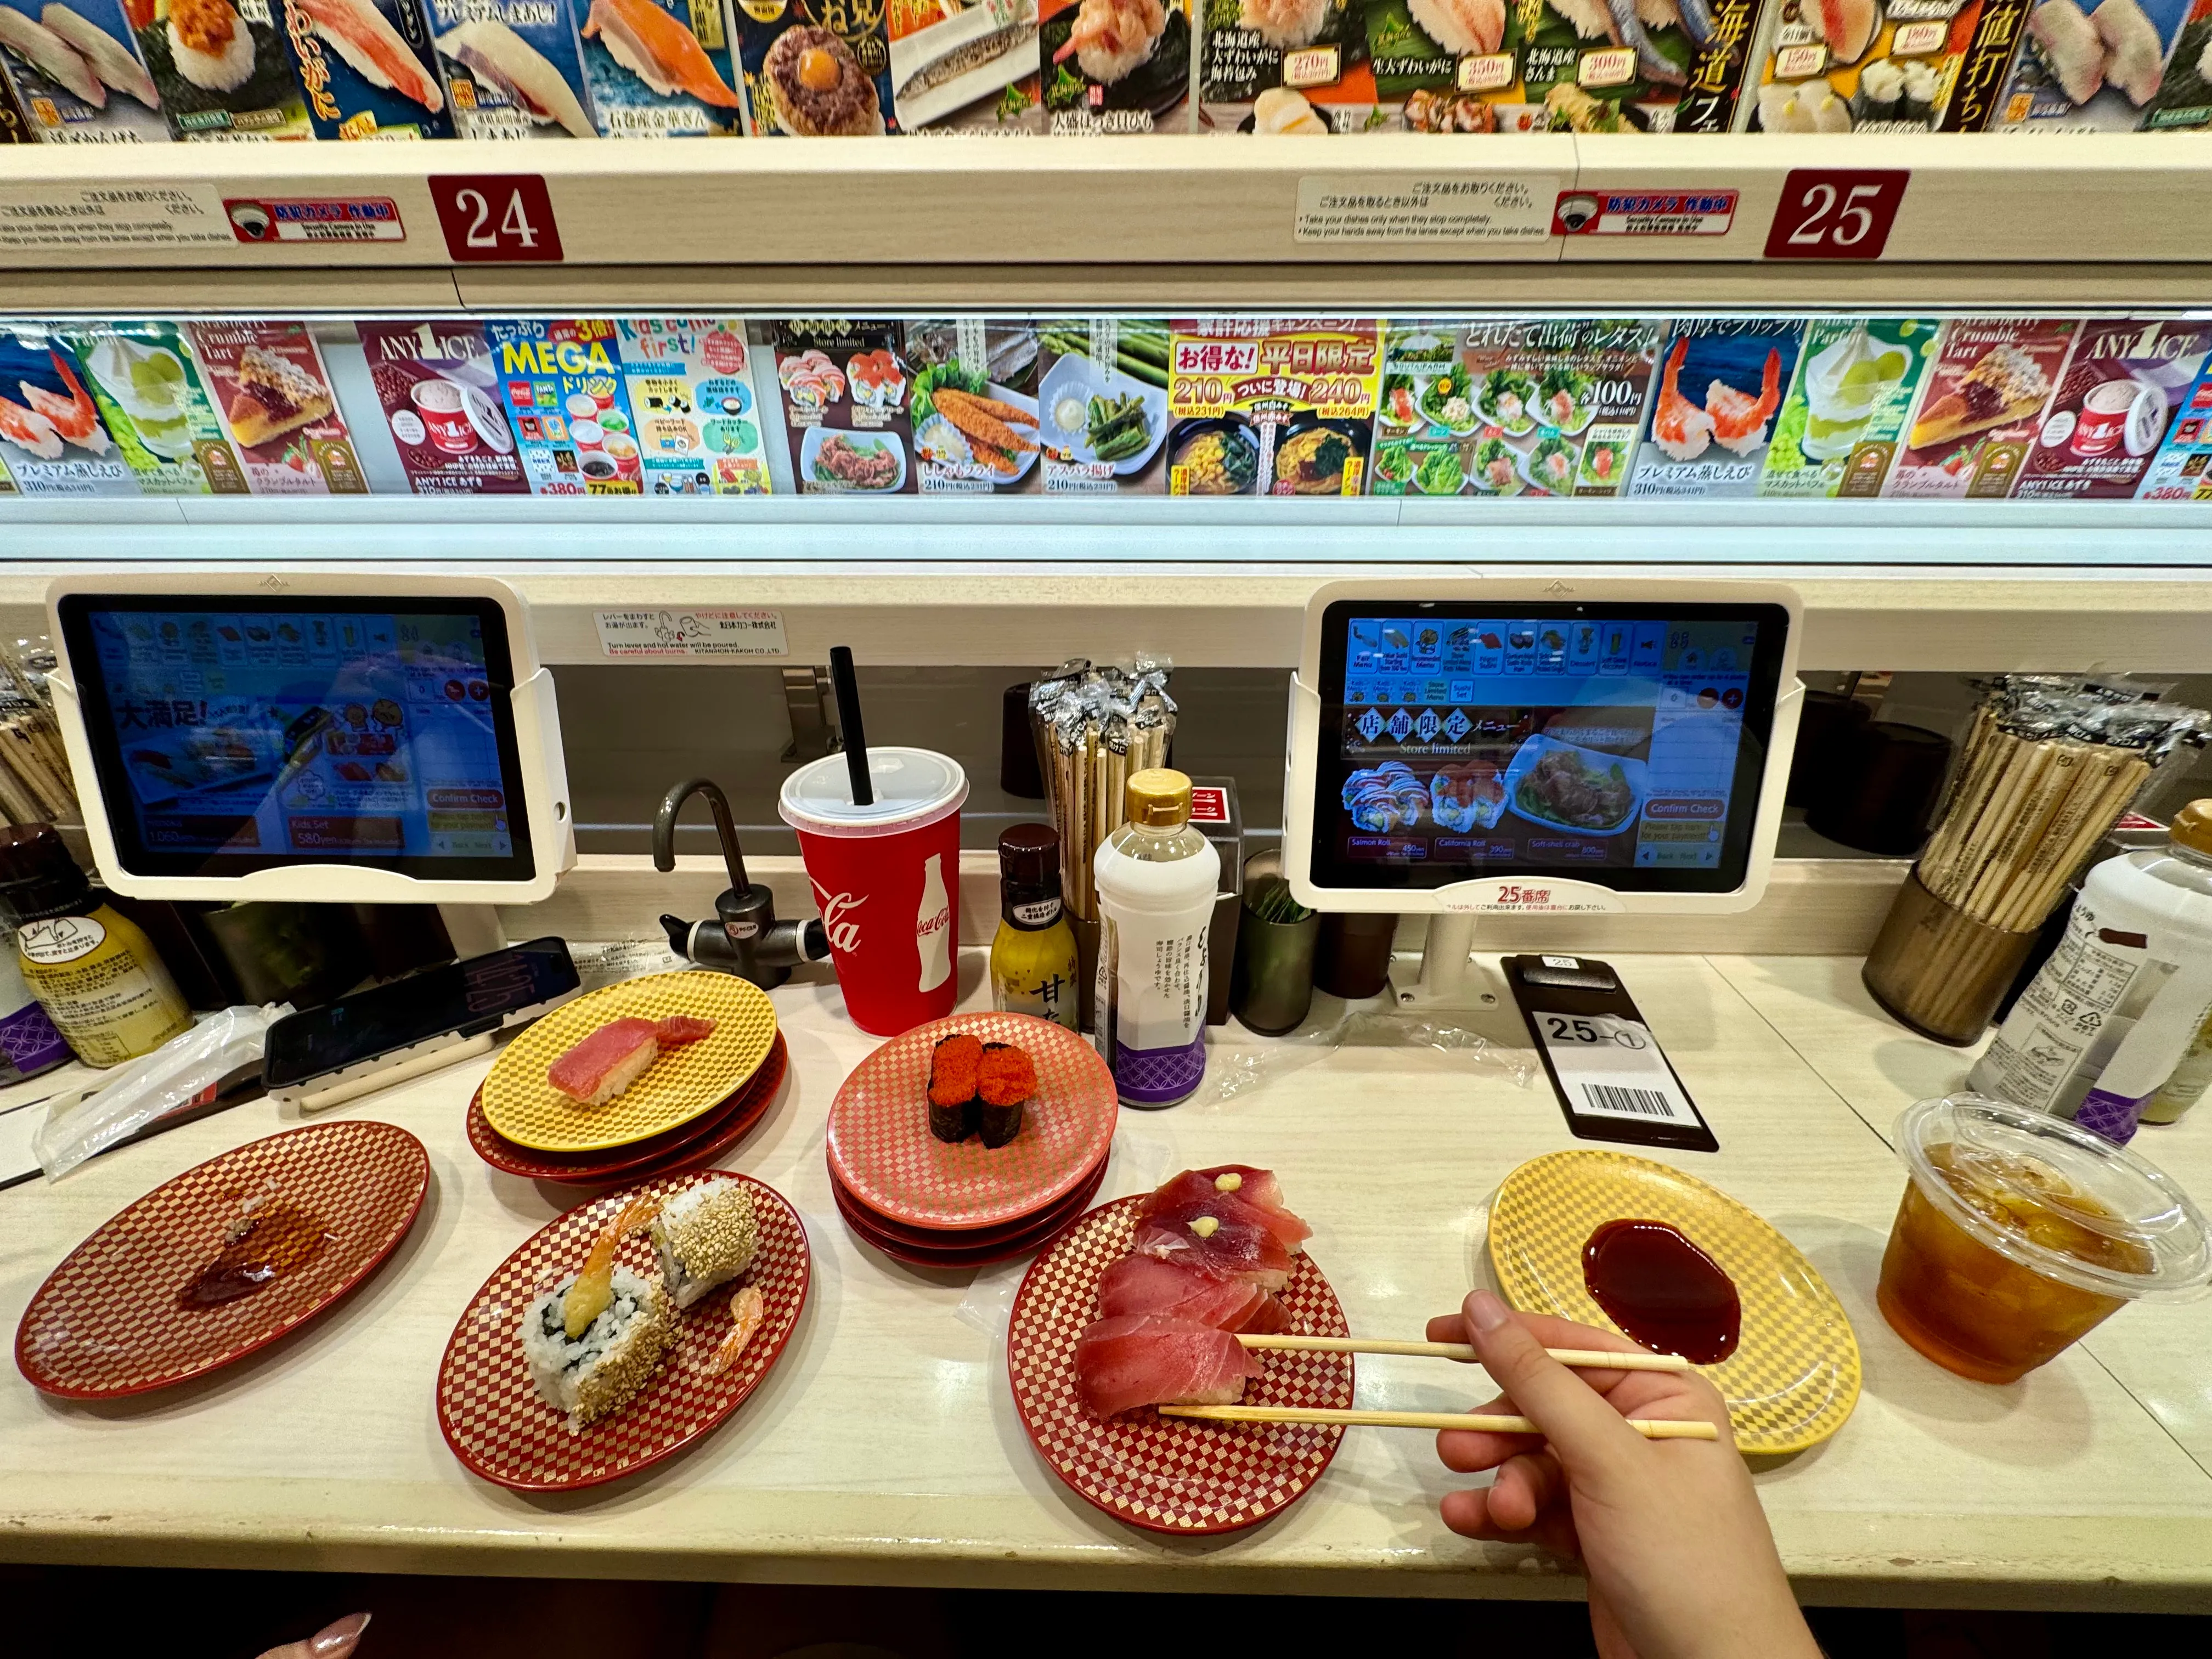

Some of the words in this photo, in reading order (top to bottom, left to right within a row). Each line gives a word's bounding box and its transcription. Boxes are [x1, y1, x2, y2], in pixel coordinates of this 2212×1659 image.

[455, 187, 539, 248] 24
[1325, 214, 1342, 225] your
[1371, 214, 1387, 225] only
[1389, 214, 1409, 225] when
[1410, 214, 1428, 225] they
[1786, 183, 1883, 246] 25
[1323, 226, 1340, 236] your
[1365, 226, 1385, 236] away
[1386, 226, 1404, 236] from
[196, 330, 258, 345] Crumble
[836, 336, 865, 347] limited
[1950, 329, 2020, 343] Crumble
[204, 346, 233, 360] Tart
[640, 333, 695, 359] first!
[1945, 343, 1978, 358] Tart
[502, 340, 616, 375] MEGA
[1178, 344, 1255, 372] お得な!
[1261, 340, 1376, 376] 平日限定
[561, 376, 617, 396] ドリンク
[1173, 377, 1233, 405] 210円
[1237, 380, 1306, 398] ついに登場!
[1310, 377, 1370, 405] 240円
[1580, 380, 1643, 405] 各100円
[1174, 405, 1225, 418] (税込231円)
[1316, 405, 1373, 418] (税込264円)
[16, 464, 123, 480] プレミアム蒸しえび
[923, 464, 995, 478] ししゃもフライ
[1047, 465, 1114, 478] アスパラ揚げ
[1638, 466, 1753, 481] プレミアム蒸しえび
[603, 612, 654, 621] レバーをまわすと
[695, 612, 777, 620] やけどに注意してください。
[605, 621, 649, 629] お湯が出ます。
[608, 641, 624, 650] Turn
[625, 641, 641, 650] lever
[643, 641, 656, 650] and
[657, 641, 669, 650] hot
[670, 641, 688, 650] water
[690, 641, 701, 650] will
[702, 641, 712, 650] be
[115, 698, 208, 730] 大満足!
[1359, 712, 1468, 737] 店舗限定
[1473, 720, 1521, 732] メニュー
[1399, 742, 1428, 754] Store
[1431, 742, 1471, 754] limited
[432, 793, 469, 803] Confirm
[470, 793, 499, 803] Check
[1651, 803, 1688, 814] Confirm
[1690, 803, 1719, 814] Check
[291, 820, 312, 830] Kids
[1497, 886, 1550, 904] 25番席
[1153, 939, 1164, 990] 寿司しょうゆです。
[1552, 957, 1573, 967] 25
